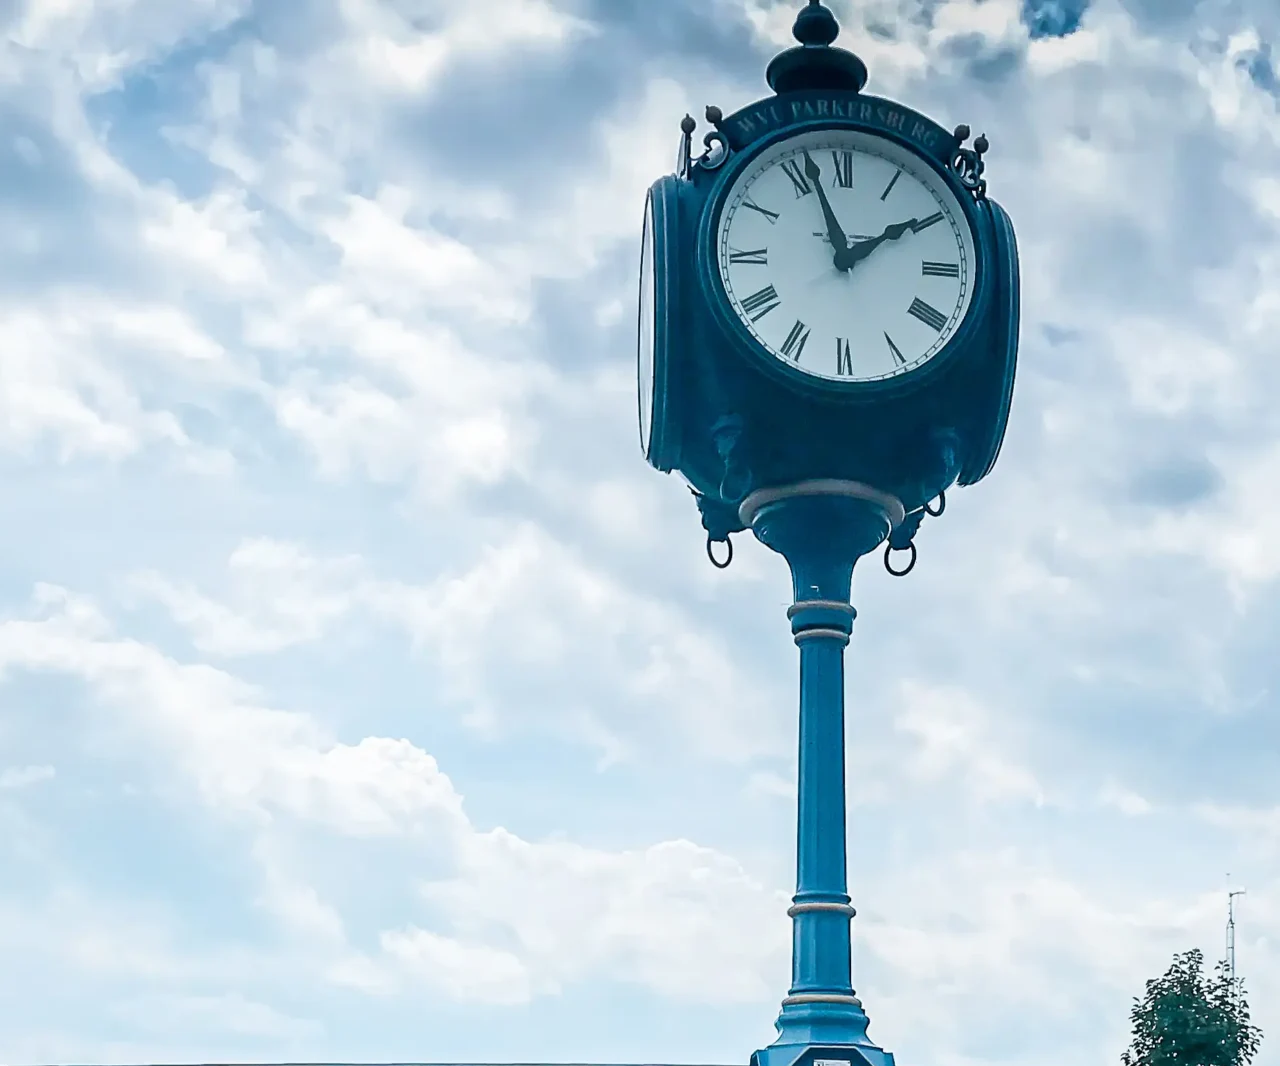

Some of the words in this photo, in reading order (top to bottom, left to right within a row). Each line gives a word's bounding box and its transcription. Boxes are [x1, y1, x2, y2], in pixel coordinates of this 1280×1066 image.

[832, 151, 854, 189] XII
[880, 168, 902, 201] I
[742, 195, 781, 226] X
[730, 247, 768, 265] IX
[922, 260, 960, 279] III
[835, 337, 854, 376] VI
[883, 330, 907, 367] V
